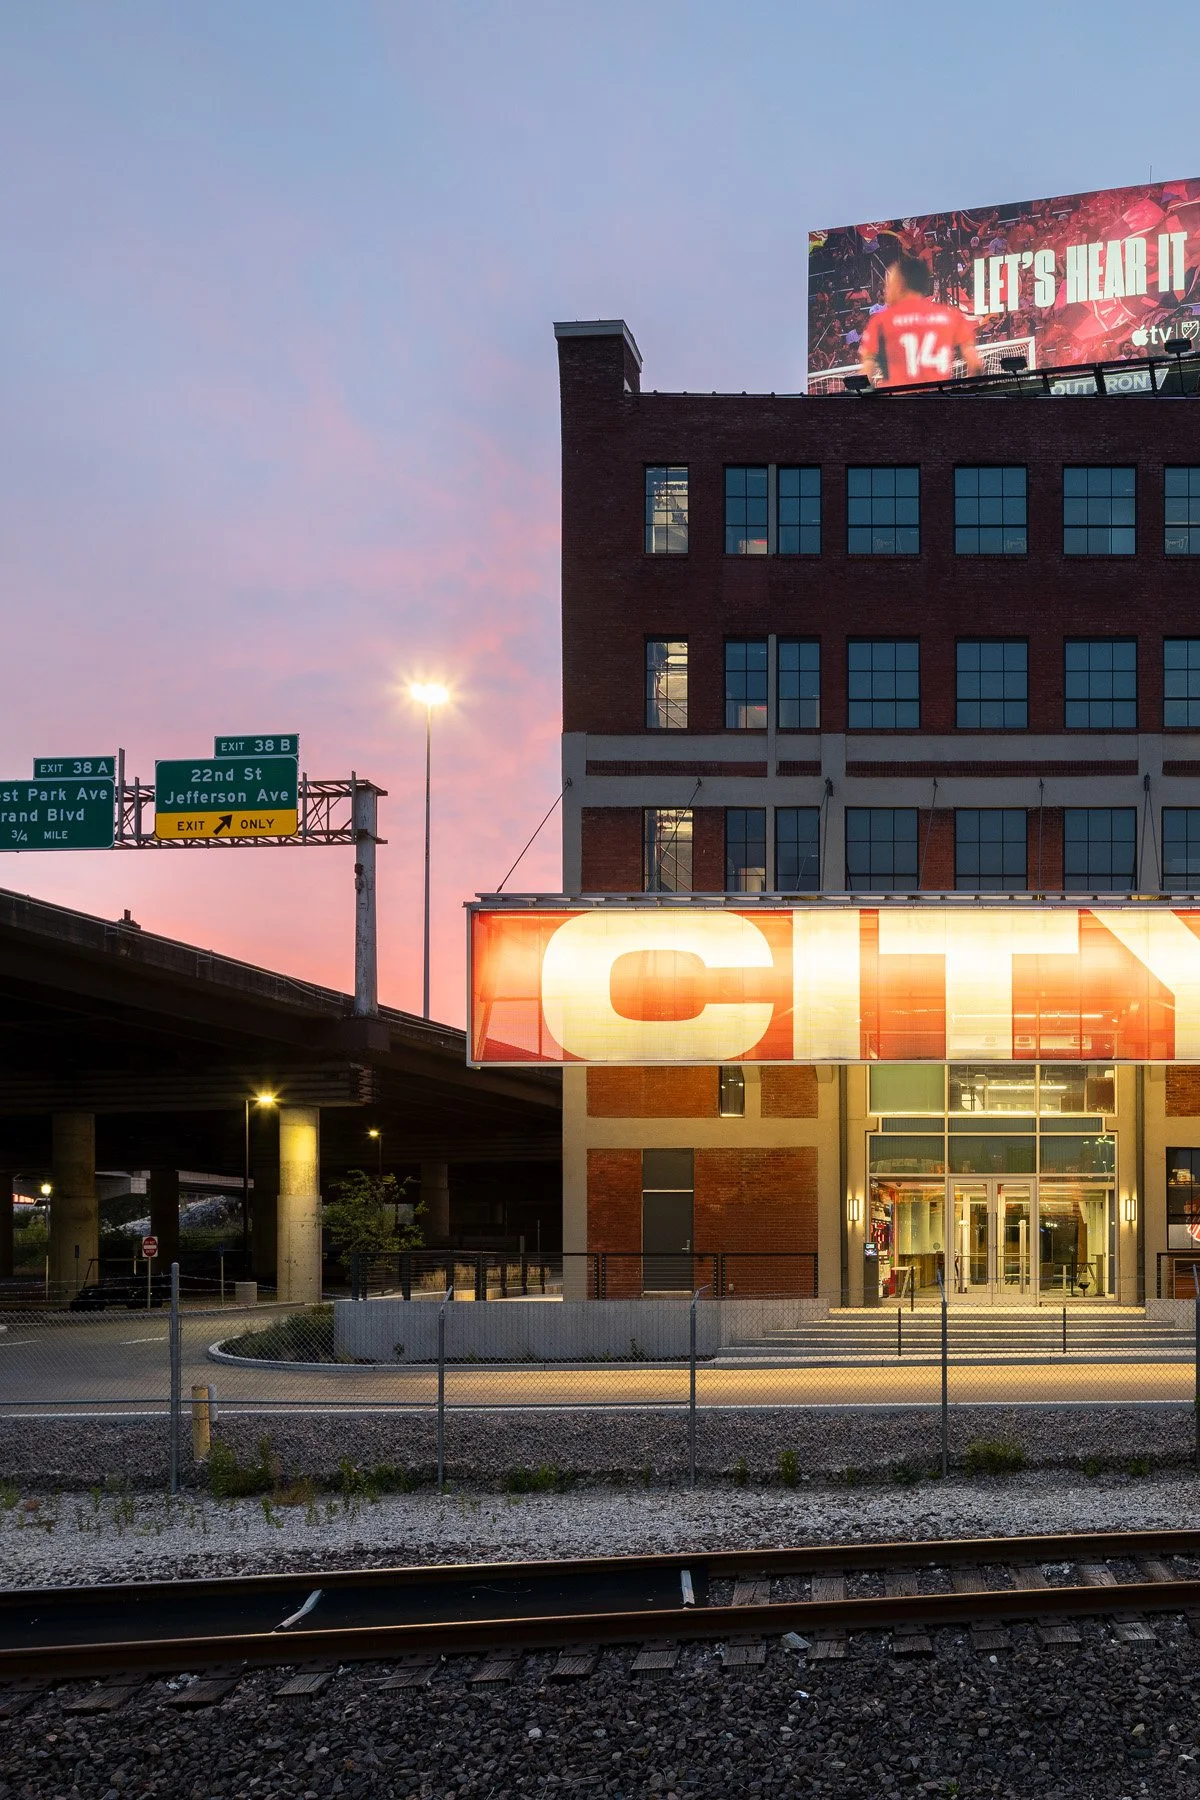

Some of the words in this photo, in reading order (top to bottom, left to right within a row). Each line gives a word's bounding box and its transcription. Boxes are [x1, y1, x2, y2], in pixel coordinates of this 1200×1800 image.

[974, 249, 1056, 316] LET'S
[1067, 237, 1147, 303] HEAR
[1158, 231, 1187, 293] IT
[899, 330, 950, 378] 14
[221, 742, 244, 751] EXIT
[254, 740, 274, 752] 38
[281, 739, 291, 751] B
[40, 764, 63, 773] EXIT
[73, 761, 92, 774] 38
[98, 761, 108, 773] A
[191, 768, 234, 783] 22nd
[244, 767, 262, 781] St
[28, 788, 66, 802] Park
[77, 787, 108, 801] Ave
[165, 790, 247, 805] Jefferson
[257, 789, 289, 802] Ave
[1, 809, 38, 822] rand
[47, 808, 84, 821] Blvd
[178, 820, 205, 832] EXIT
[240, 818, 275, 830] ONLY
[44, 830, 68, 840] MILE
